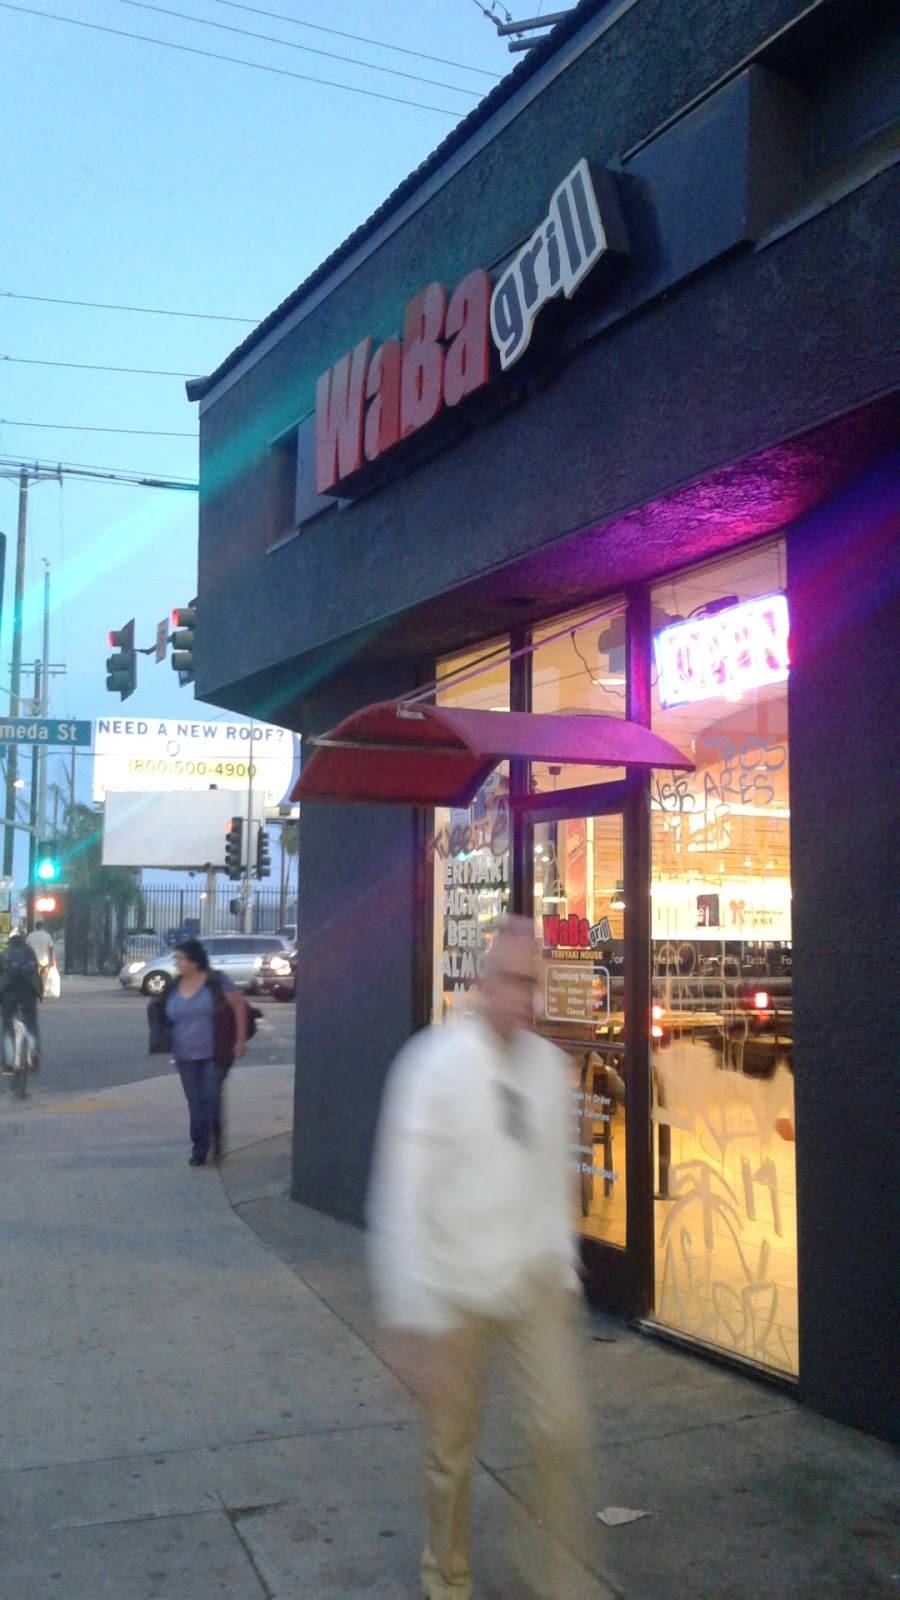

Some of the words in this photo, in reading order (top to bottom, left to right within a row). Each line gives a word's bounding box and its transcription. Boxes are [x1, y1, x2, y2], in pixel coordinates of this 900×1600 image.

[316, 267, 491, 496] WaBa
[490, 158, 608, 371] grill
[0, 722, 49, 741] meda
[56, 722, 78, 741] St
[98, 719, 149, 735] NEED
[157, 723, 168, 736] A
[176, 724, 219, 738] NEW
[225, 726, 285, 742] ROOF?
[543, 913, 590, 946] WaBa
[589, 916, 612, 949] grill
[551, 950, 579, 960] TERIYAKI
[580, 950, 604, 961] HOUSE
